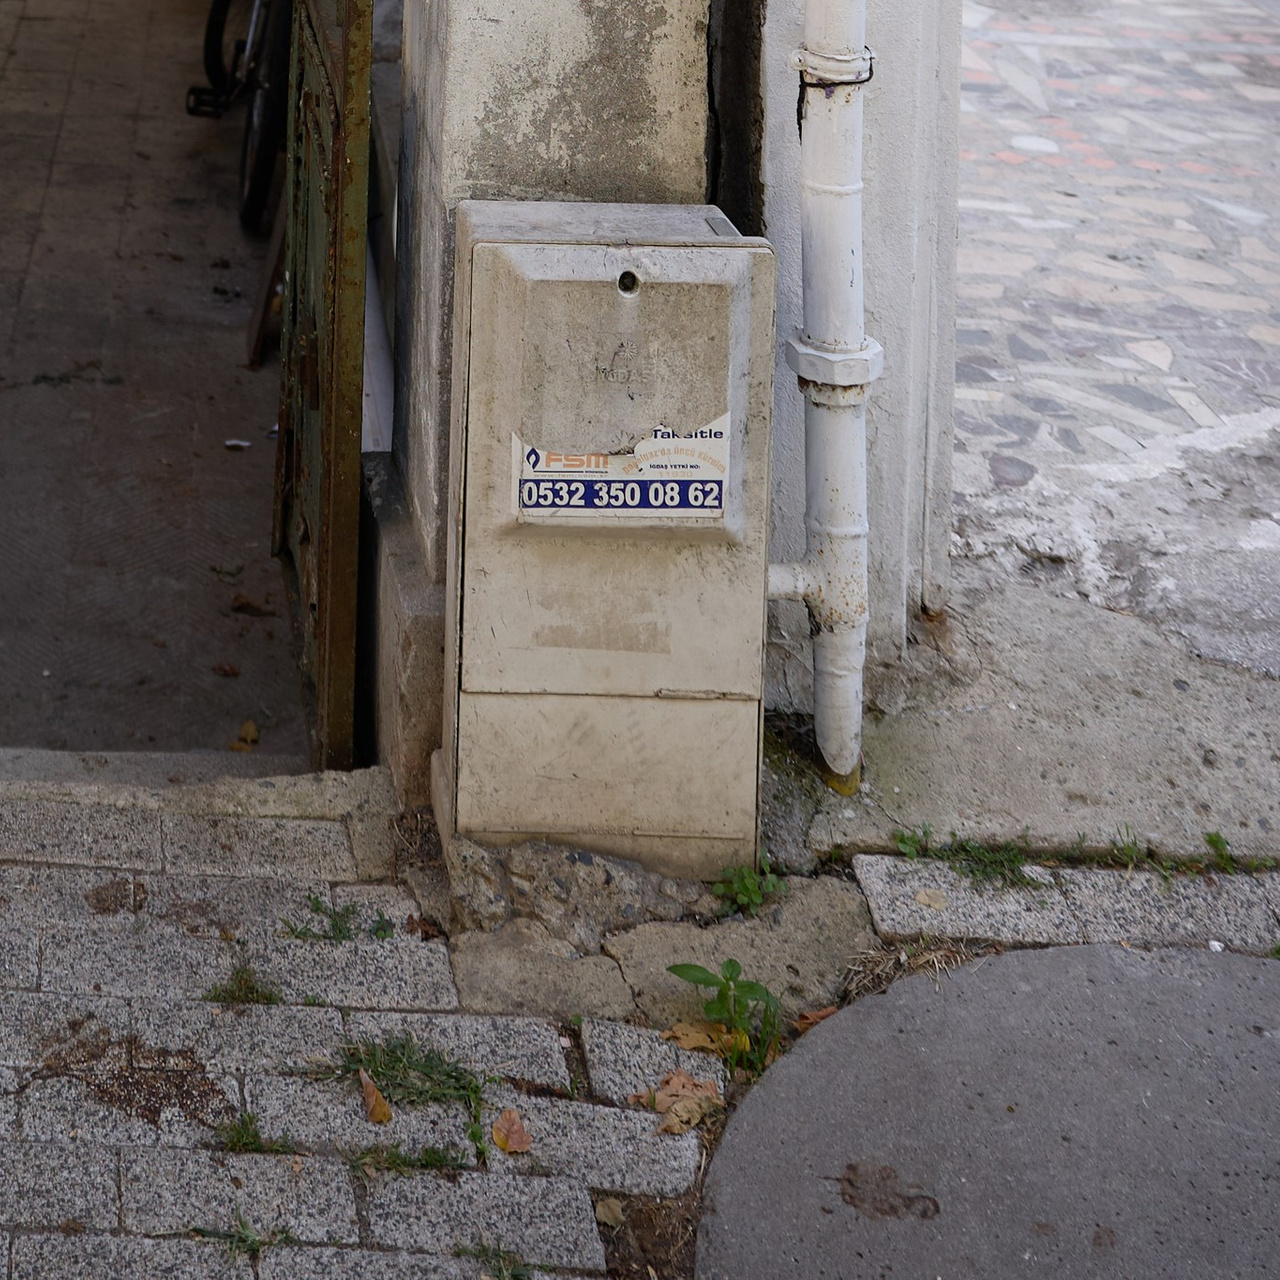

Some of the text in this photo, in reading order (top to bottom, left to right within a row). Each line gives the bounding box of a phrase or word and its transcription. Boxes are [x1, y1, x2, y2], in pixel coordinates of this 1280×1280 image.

[522, 482, 719, 507] 0532 350 08 62
